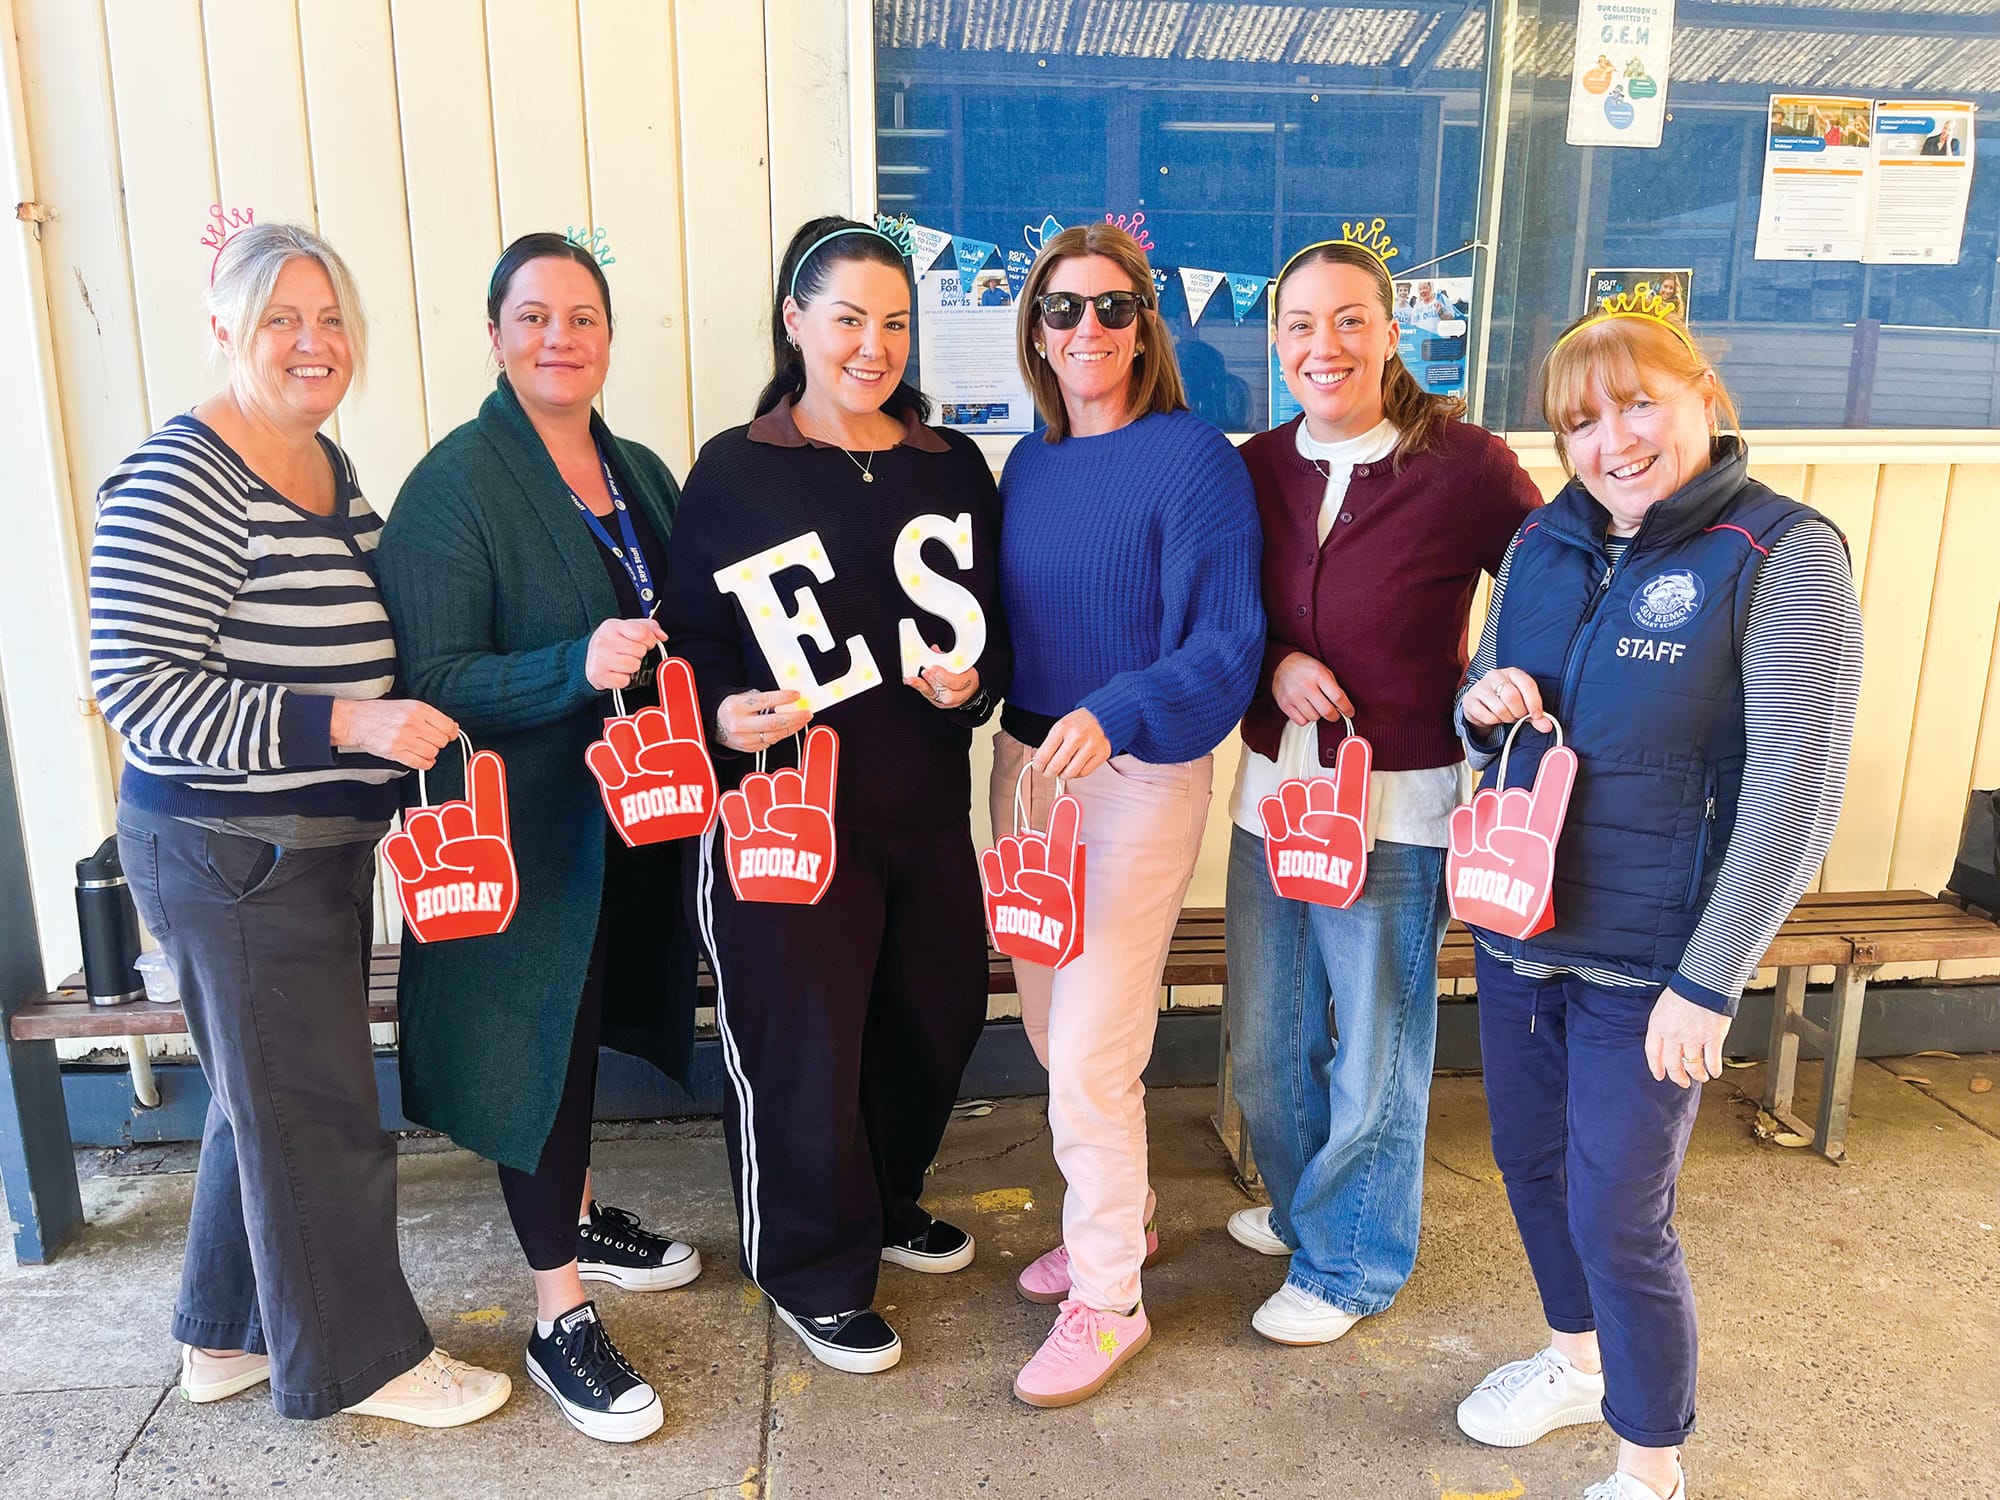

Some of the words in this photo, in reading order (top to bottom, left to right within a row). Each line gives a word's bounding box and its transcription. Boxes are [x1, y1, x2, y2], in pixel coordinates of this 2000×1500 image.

[1603, 13, 1641, 22] COMMITTED
[1643, 15, 1651, 23] TO
[1612, 5, 1650, 14] CLASSROOM
[1774, 137, 1798, 145] Connected
[917, 230, 926, 238] GO
[926, 240, 938, 248] END
[941, 278, 955, 286] DO
[713, 531, 883, 714] E
[893, 512, 986, 684] S
[1635, 611, 1658, 628] PRIMARY
[1660, 616, 1688, 628] SCHOOL
[1639, 604, 1654, 620] SAN
[1655, 607, 1688, 623] REMO
[1616, 637, 1687, 664] STAFF
[620, 784, 704, 827] HOORAY
[738, 848, 822, 883] HOORAY
[1276, 849, 1354, 889] HOORAY
[415, 881, 503, 923] HOORAY
[1454, 866, 1536, 918] HOORAY
[995, 905, 1065, 951] HOORAY
